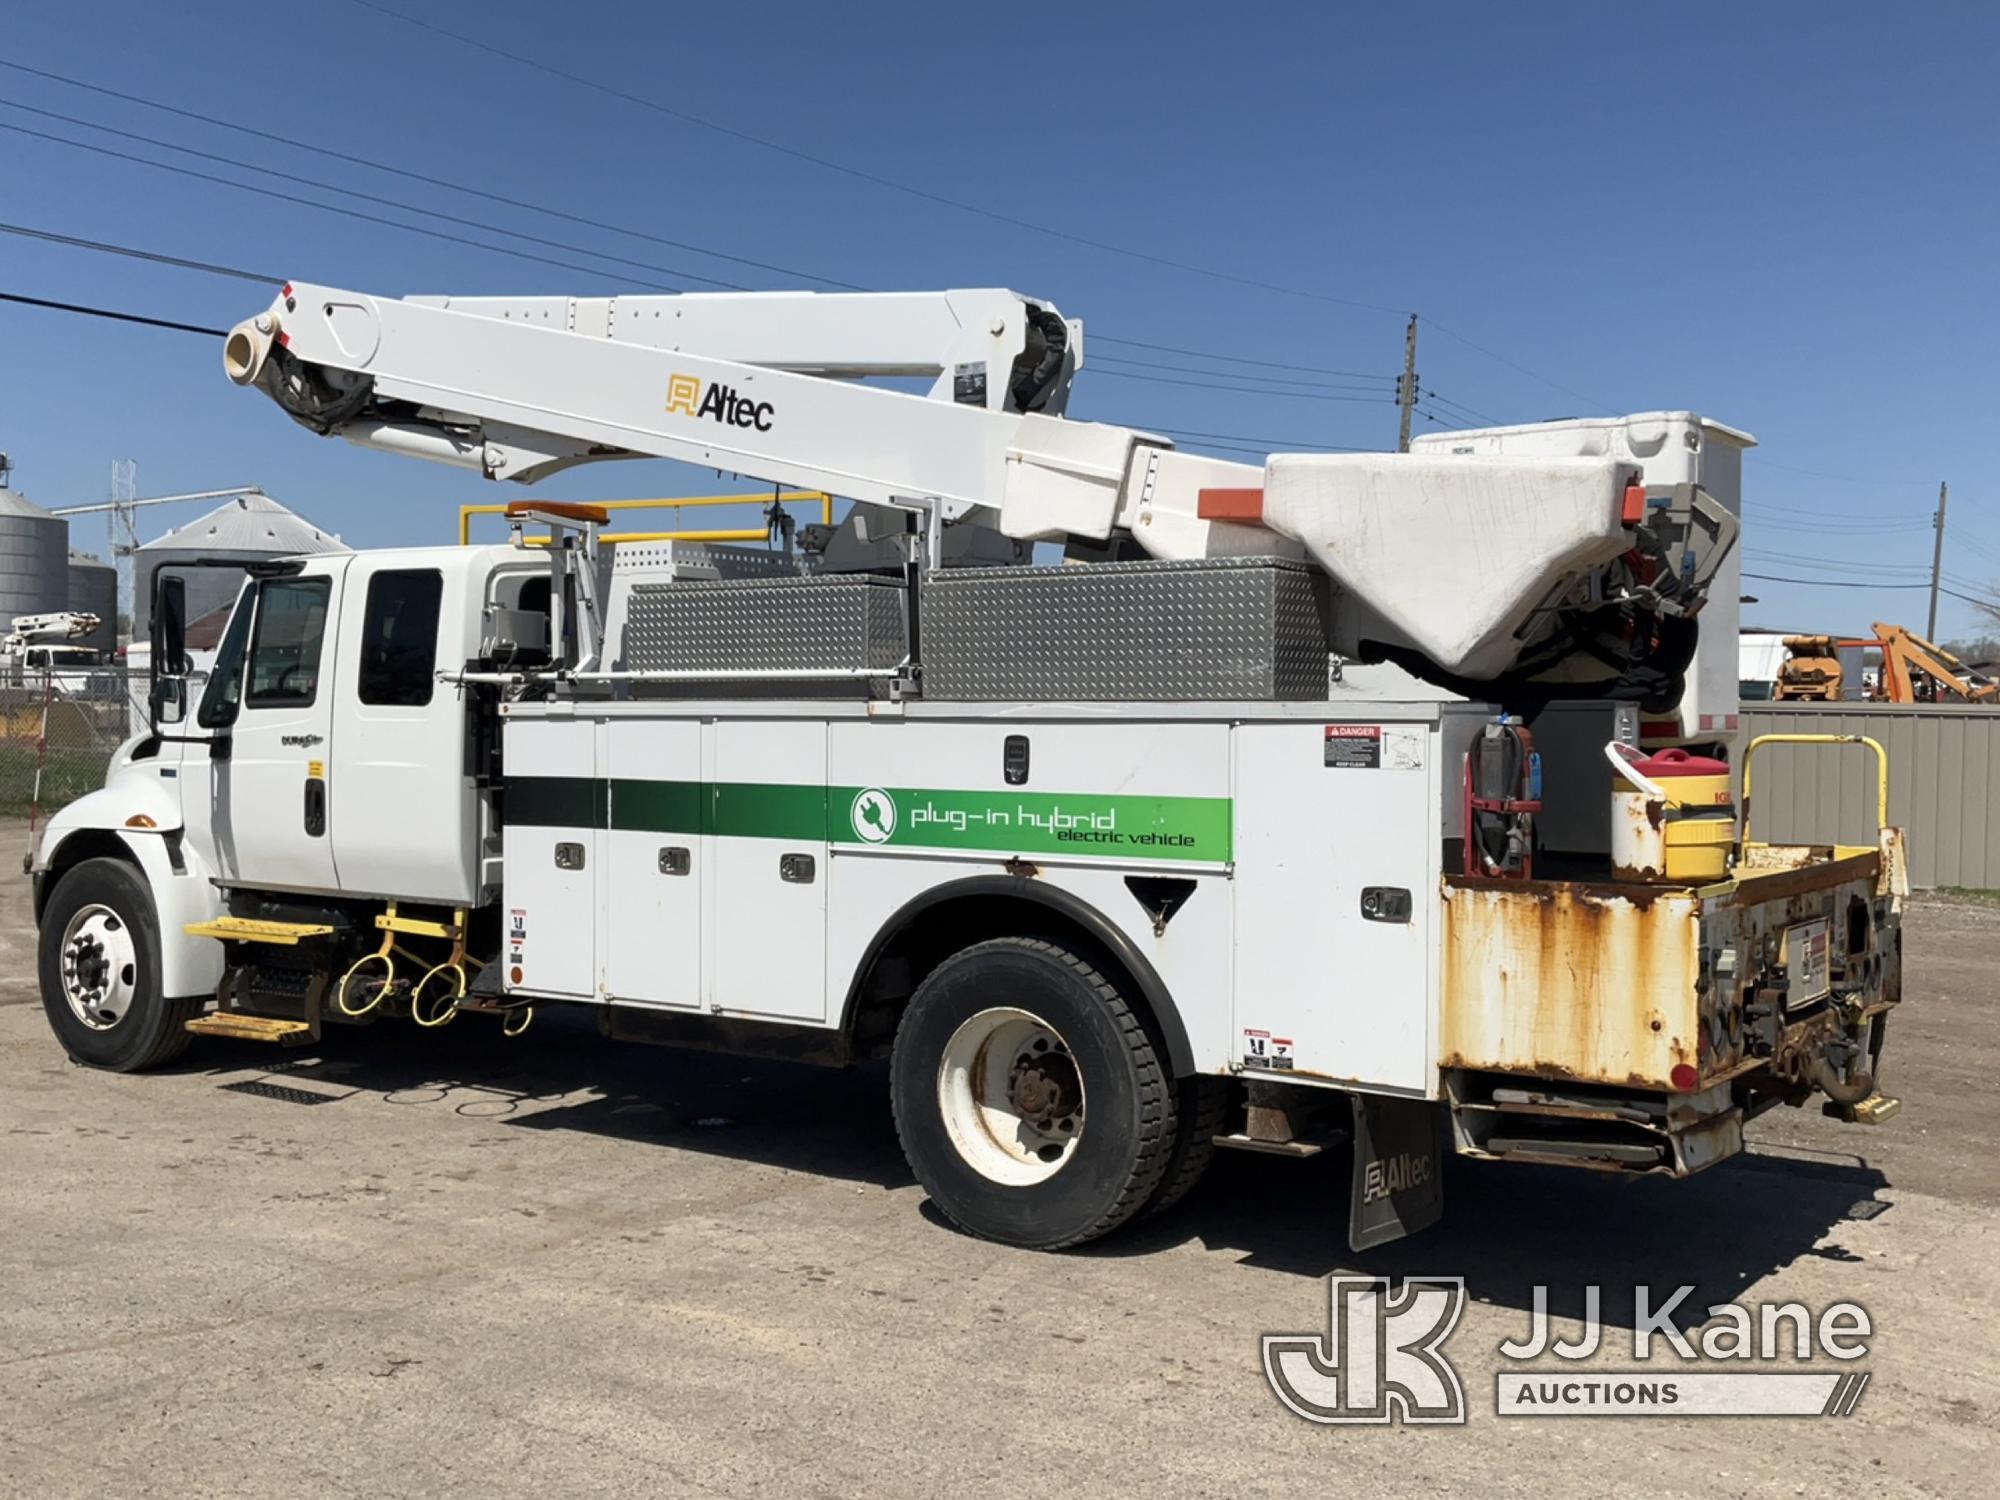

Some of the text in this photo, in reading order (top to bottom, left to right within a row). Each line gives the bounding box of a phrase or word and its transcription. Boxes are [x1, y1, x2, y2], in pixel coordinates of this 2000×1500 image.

[697, 382, 775, 432] Altec
[1340, 728, 1375, 736] DANGER
[910, 801, 1116, 834] plug-in hybrid
[1056, 830, 1196, 847] electric vehicle
[1387, 1153, 1432, 1192] Altec
